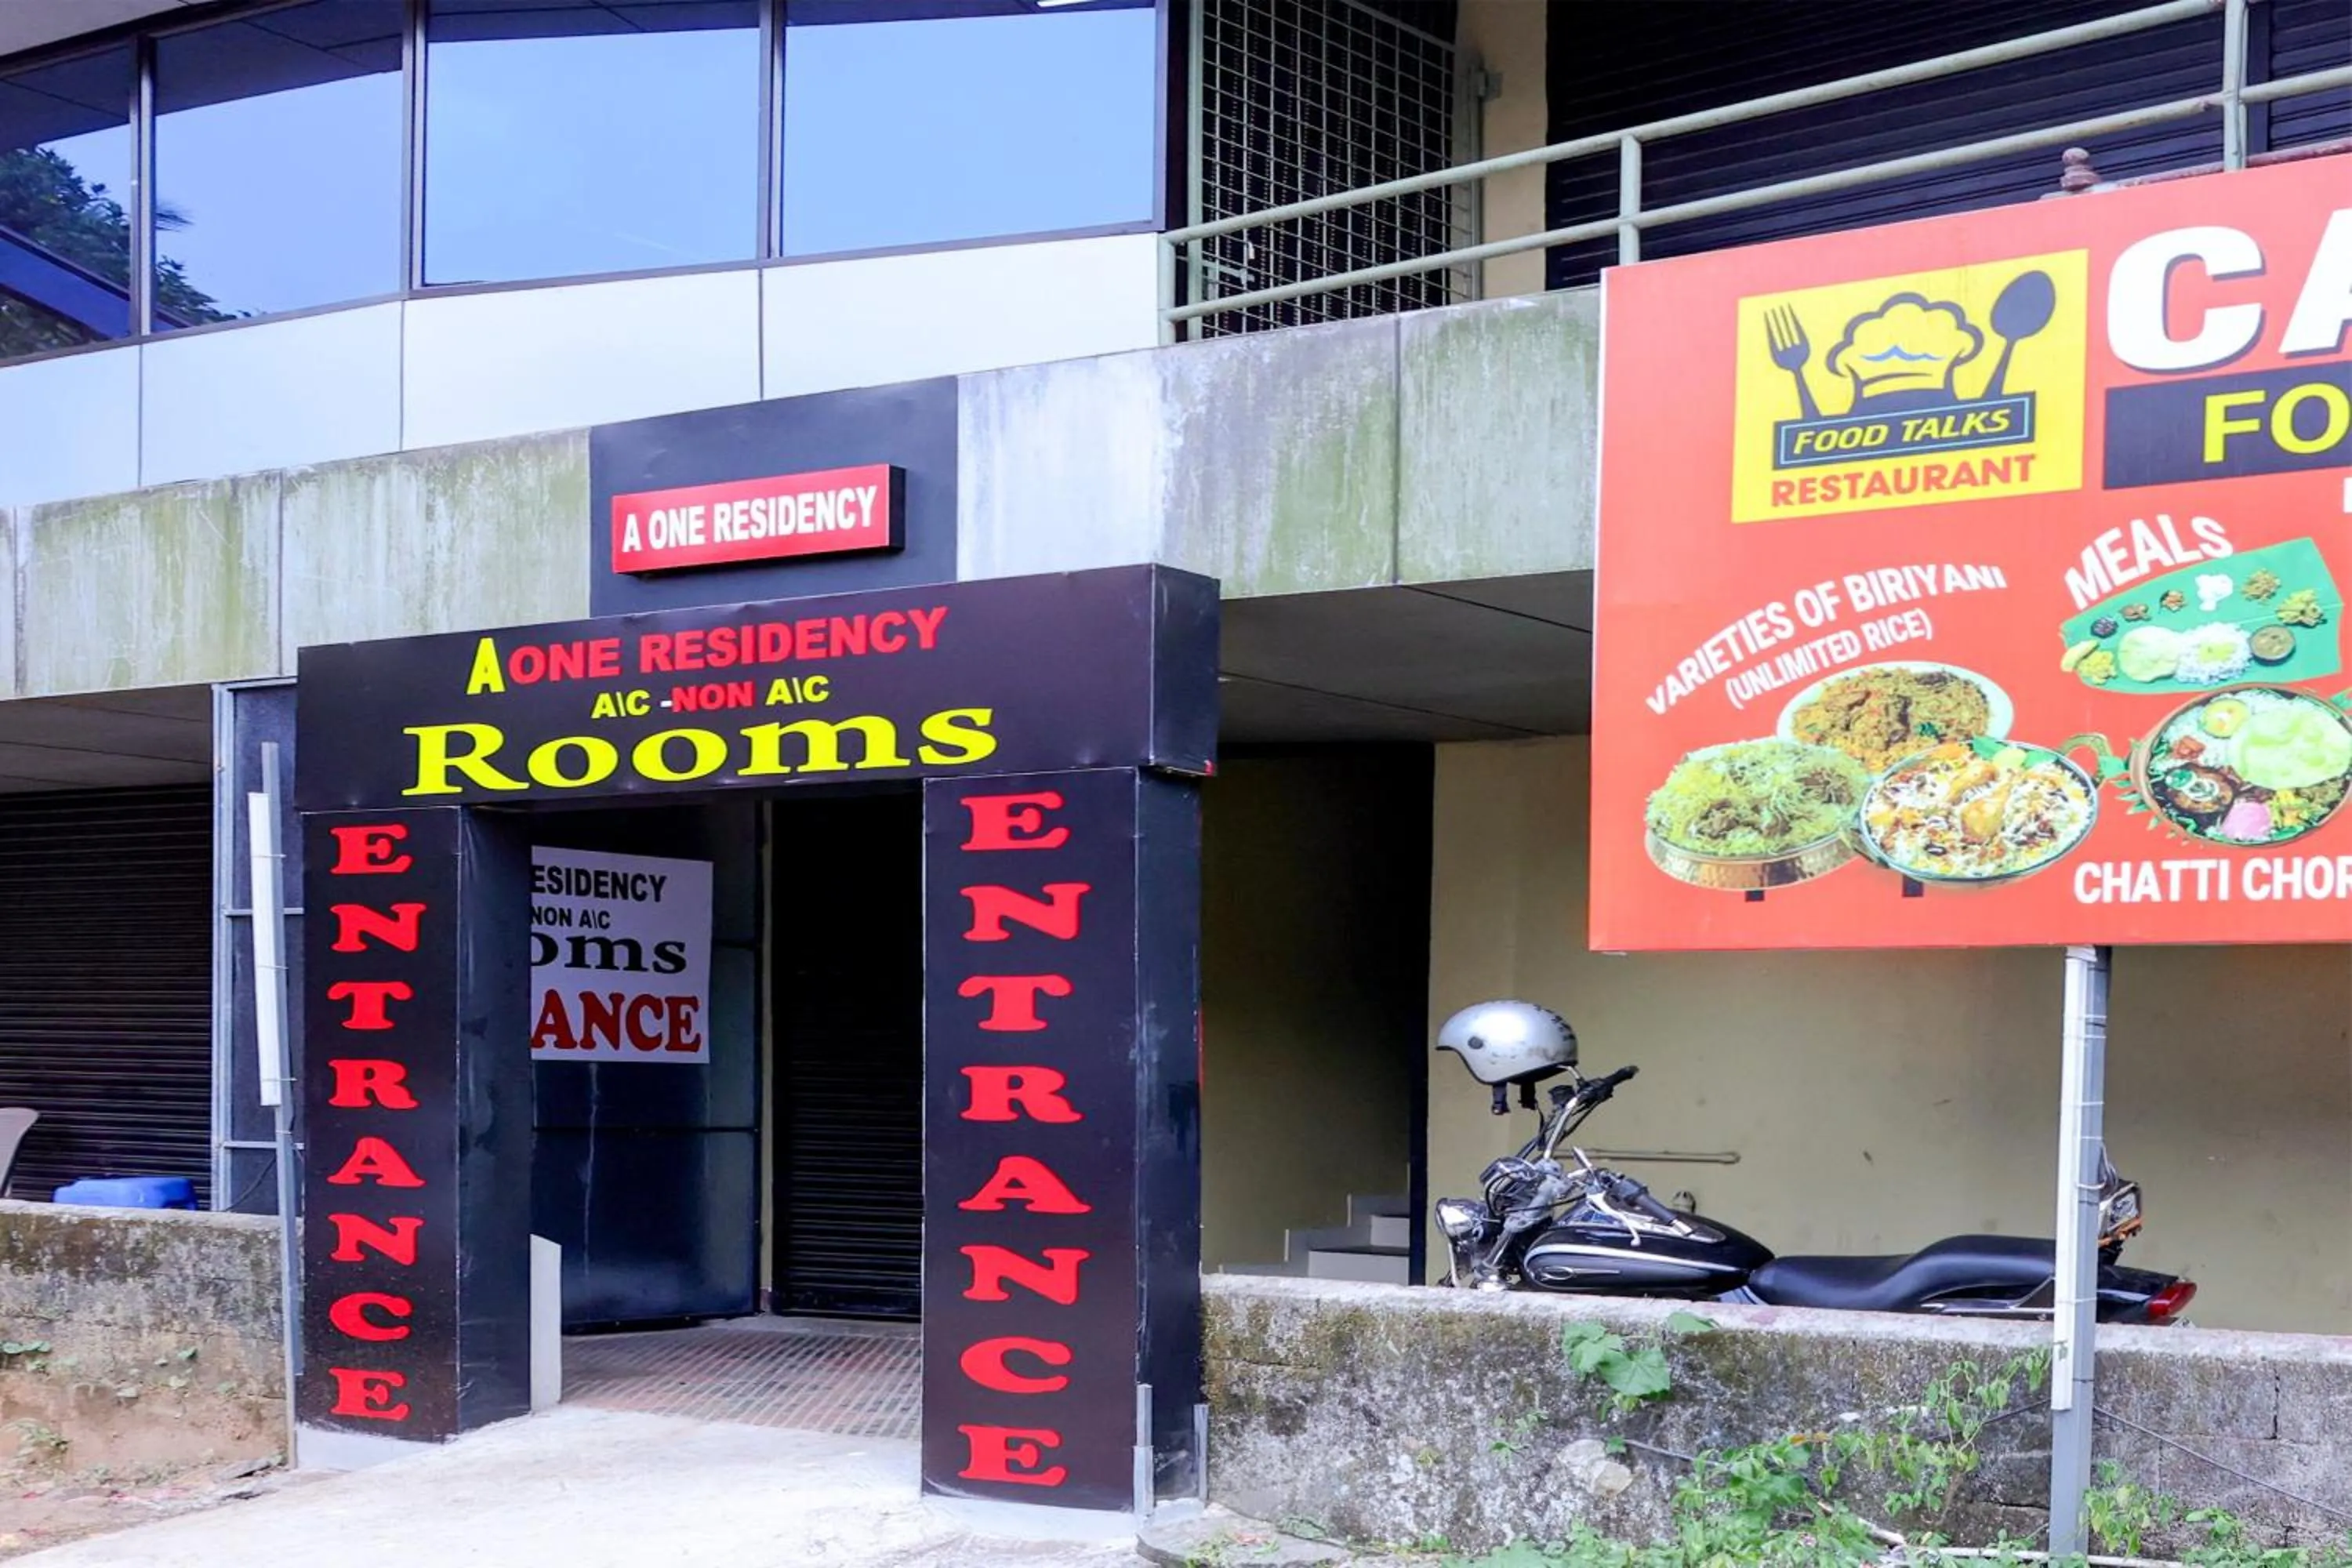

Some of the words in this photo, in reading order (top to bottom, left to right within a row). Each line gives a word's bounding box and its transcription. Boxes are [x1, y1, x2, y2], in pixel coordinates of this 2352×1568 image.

[1793, 424, 1889, 455] FOOD
[1901, 408, 2011, 442] TALKS
[2204, 383, 2352, 463] FO
[622, 514, 641, 553] A
[648, 506, 706, 549] ONE
[713, 486, 877, 543] RESIDENCY
[1771, 454, 2035, 507] RESTAURANT
[2063, 514, 2234, 611] MEALS
[639, 606, 948, 673] RESIDENCY
[1646, 601, 1795, 714] VARIETIES
[1794, 581, 1842, 628] OF
[1843, 564, 2007, 612] BIRIYANI
[1726, 630, 1860, 710] (UNLIMITED
[1860, 608, 1933, 653] RICE)
[401, 707, 998, 796] Rooms
[2074, 859, 2231, 904] CHATTI
[531, 989, 702, 1053] ANCE
[328, 823, 427, 1424] ENTRANCE
[957, 791, 1092, 1488] ENTRANCE
